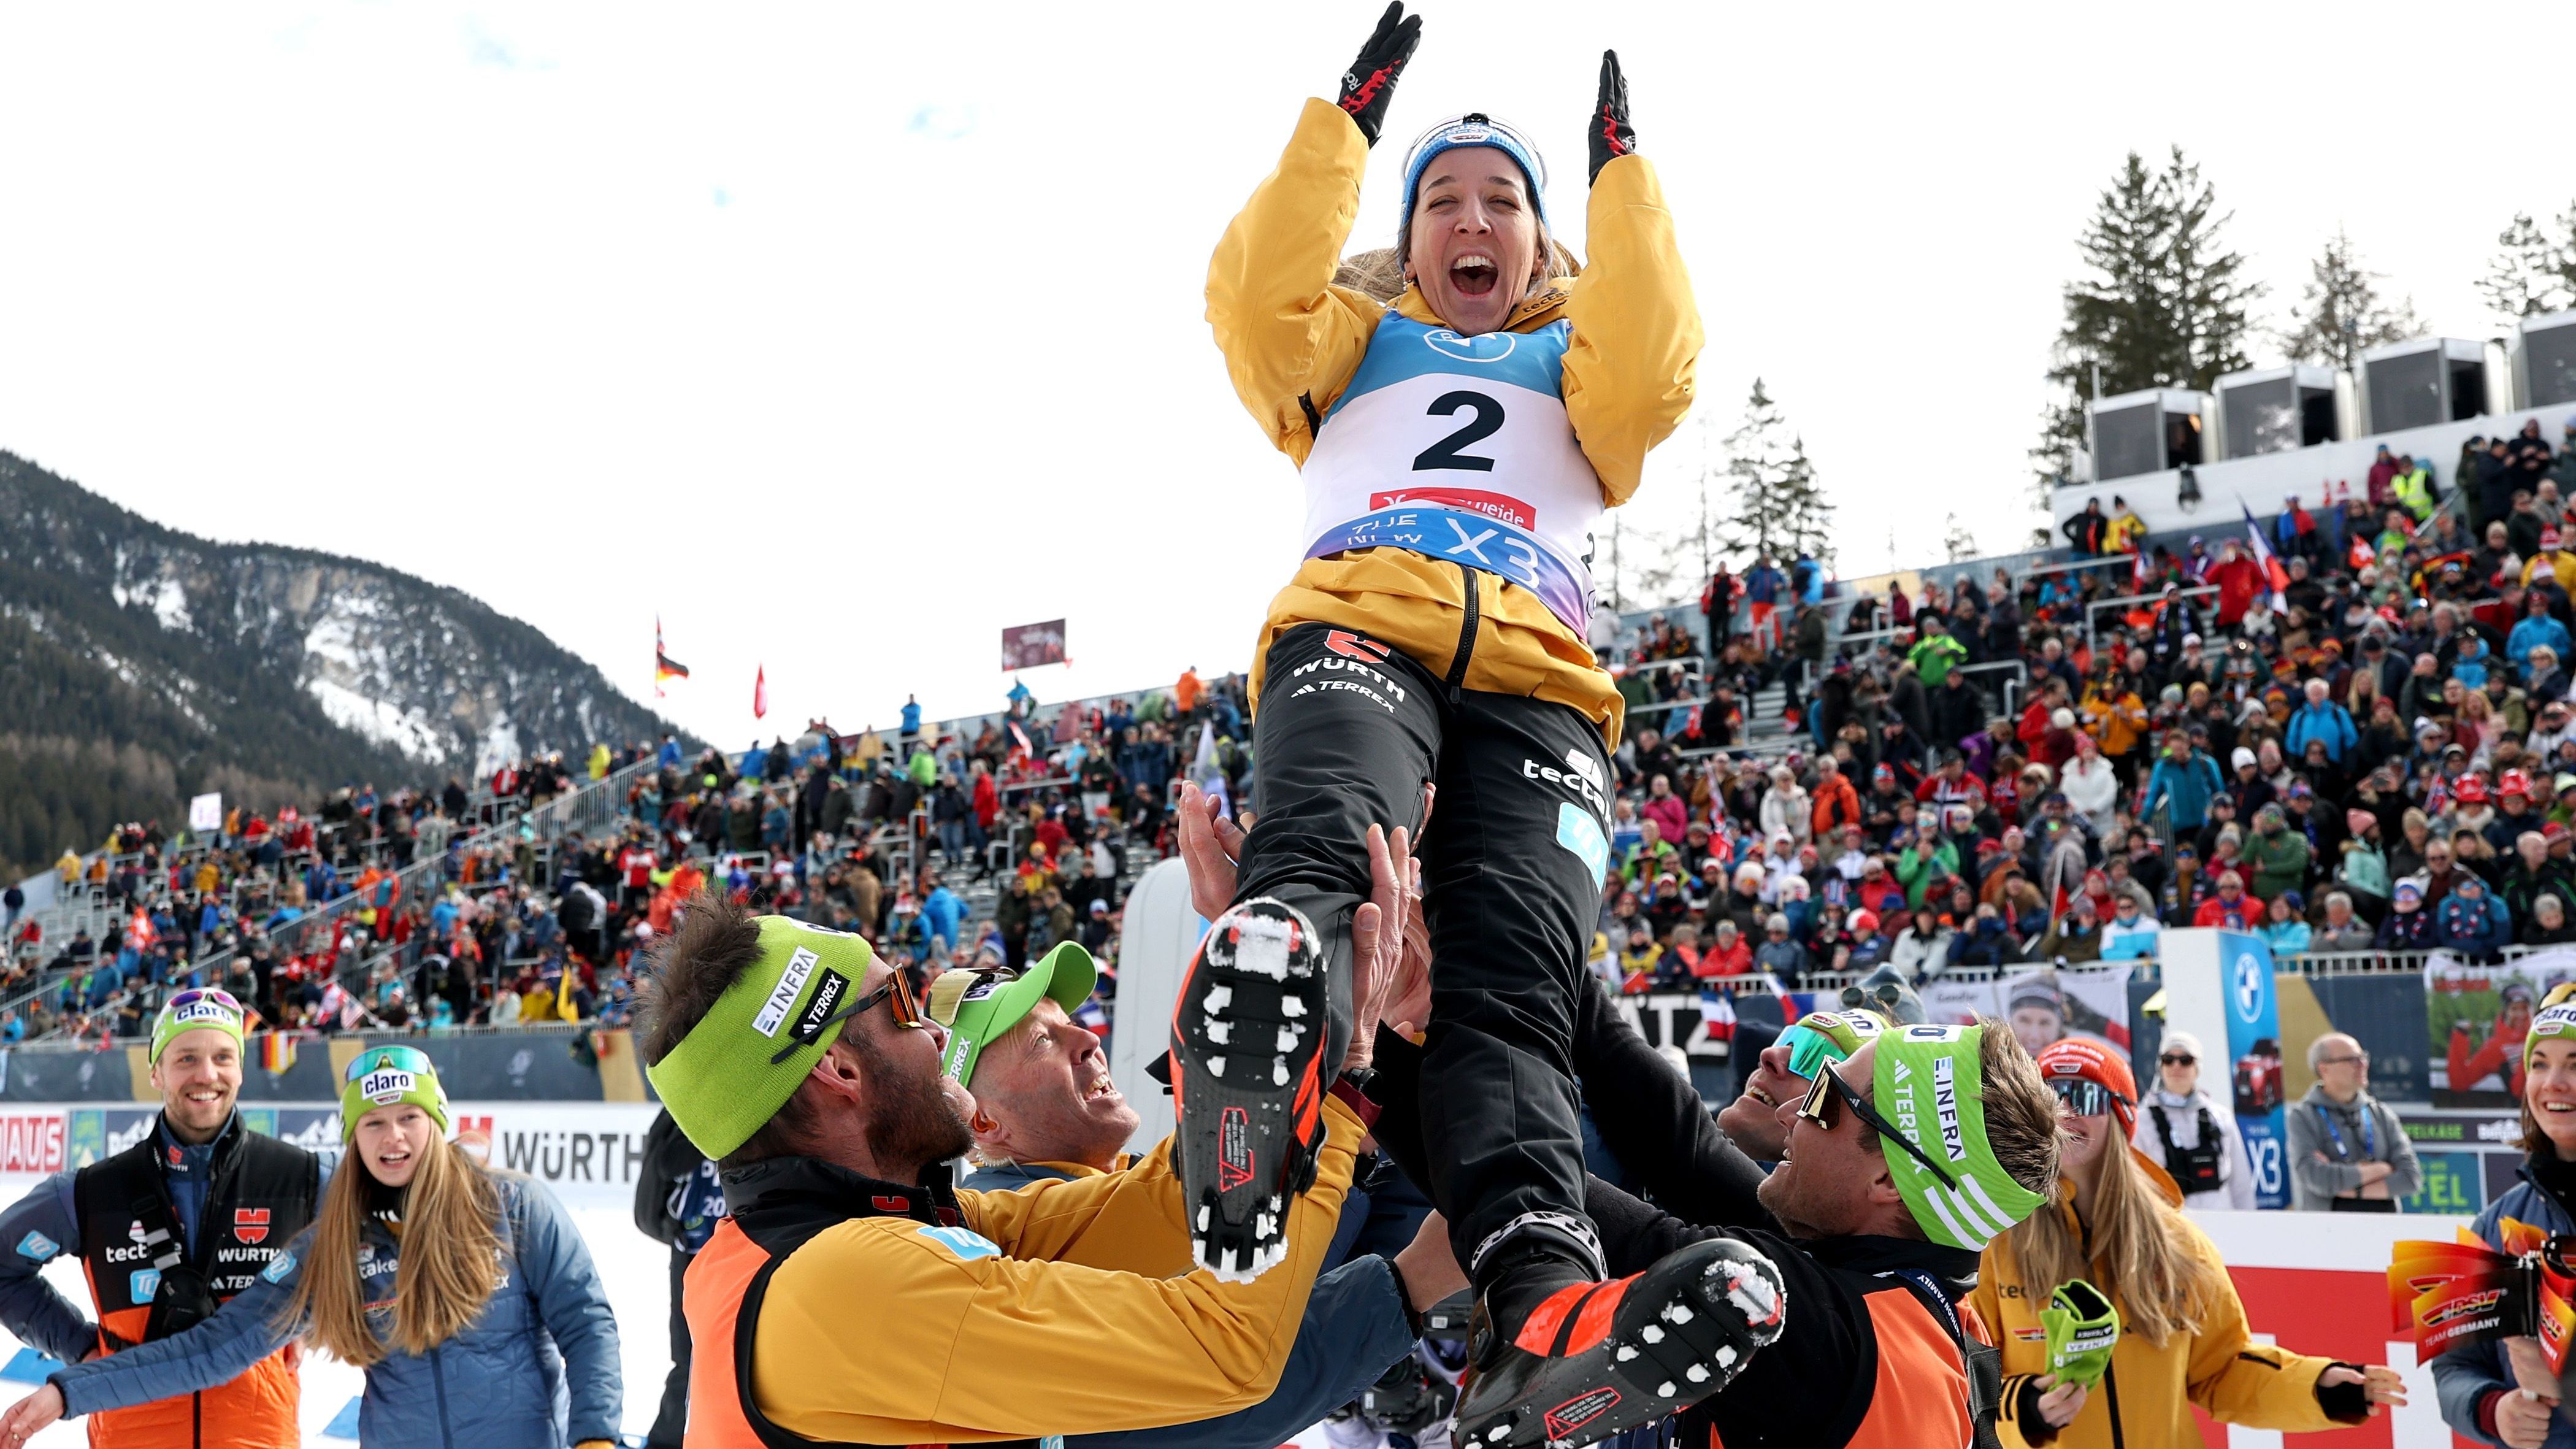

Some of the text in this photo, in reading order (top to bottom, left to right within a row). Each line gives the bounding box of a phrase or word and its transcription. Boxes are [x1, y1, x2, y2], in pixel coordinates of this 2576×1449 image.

[1412, 390, 1506, 472] 2
[1444, 517, 1541, 589] X3
[1319, 680, 1395, 714] TERREX
[177, 1004, 231, 1021] claro
[808, 973, 842, 1023] TERREX
[365, 1074, 410, 1095] claro
[1, 1118, 64, 1171] AUS
[2247, 1137, 2282, 1194] X3
[1916, 1274, 1946, 1304] FAMILY
[2425, 1316, 2501, 1347] TEAM GERMANY
